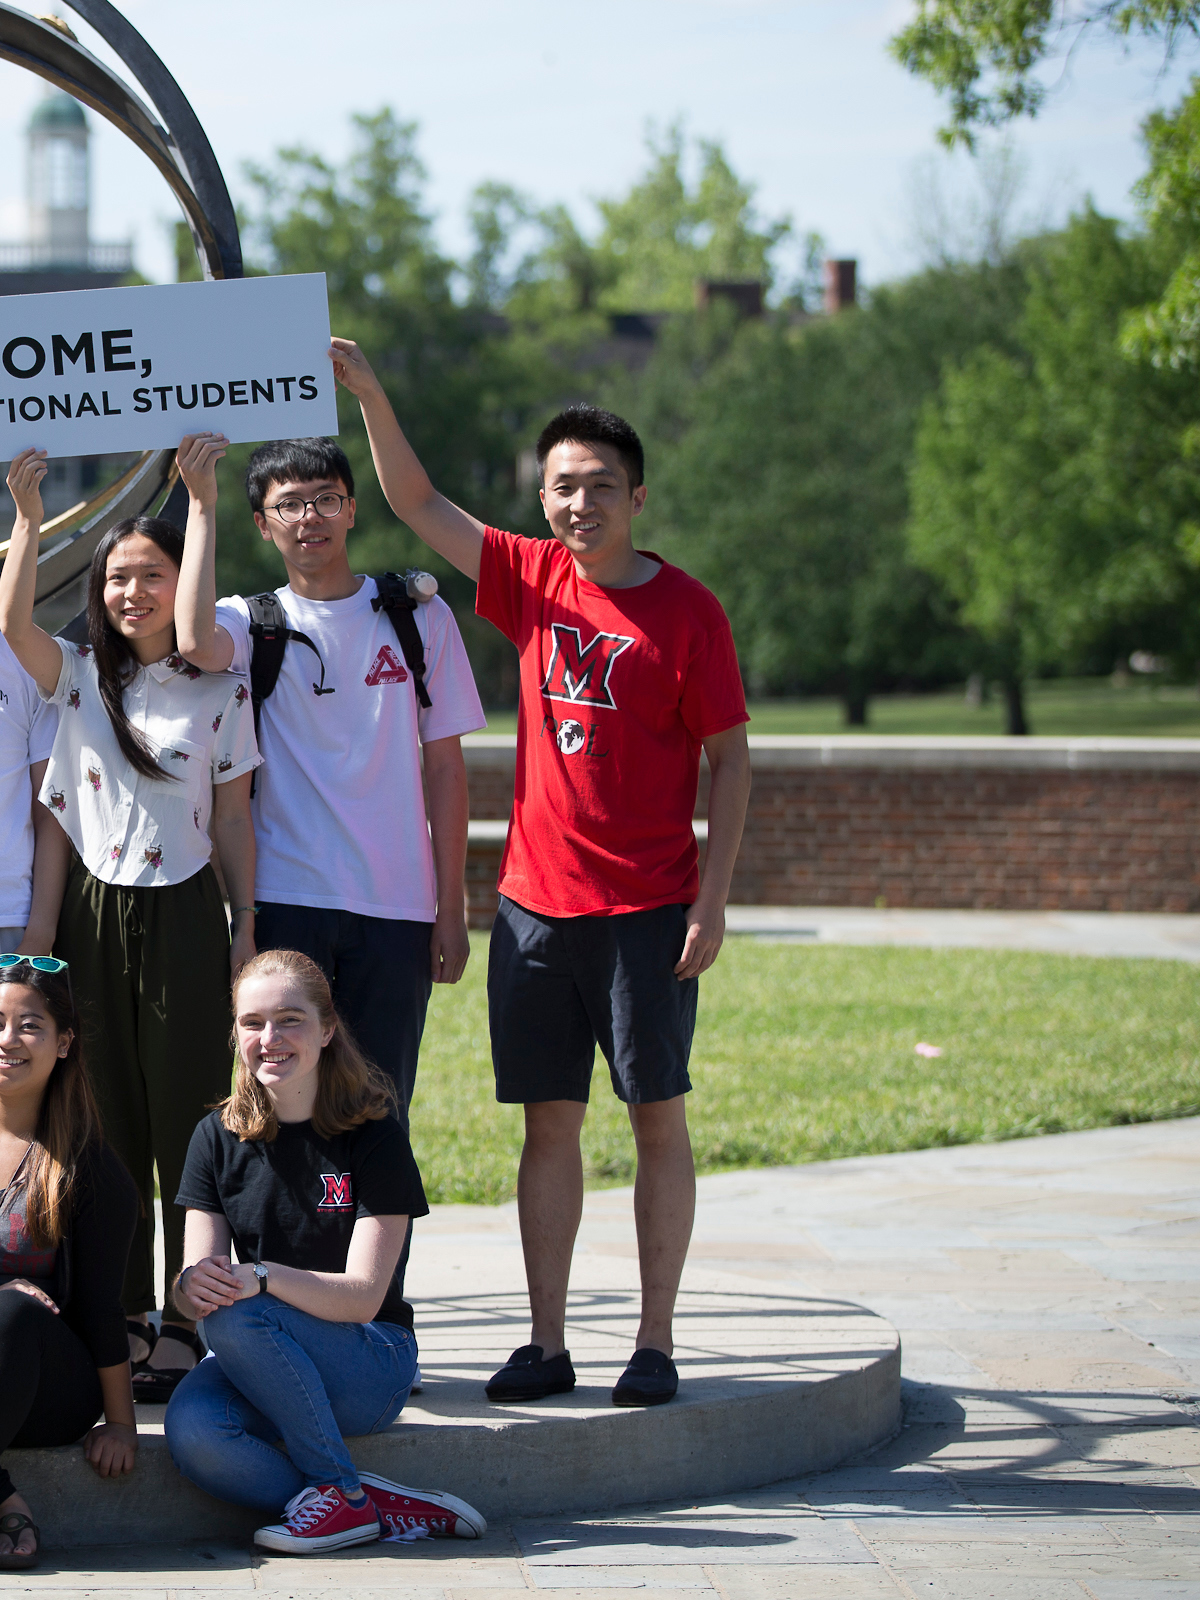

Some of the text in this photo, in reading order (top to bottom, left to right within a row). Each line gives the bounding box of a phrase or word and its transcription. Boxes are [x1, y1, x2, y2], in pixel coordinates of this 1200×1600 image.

[132, 375, 318, 413] STUDENTS
[539, 623, 636, 710] M
[318, 1172, 354, 1207] M
